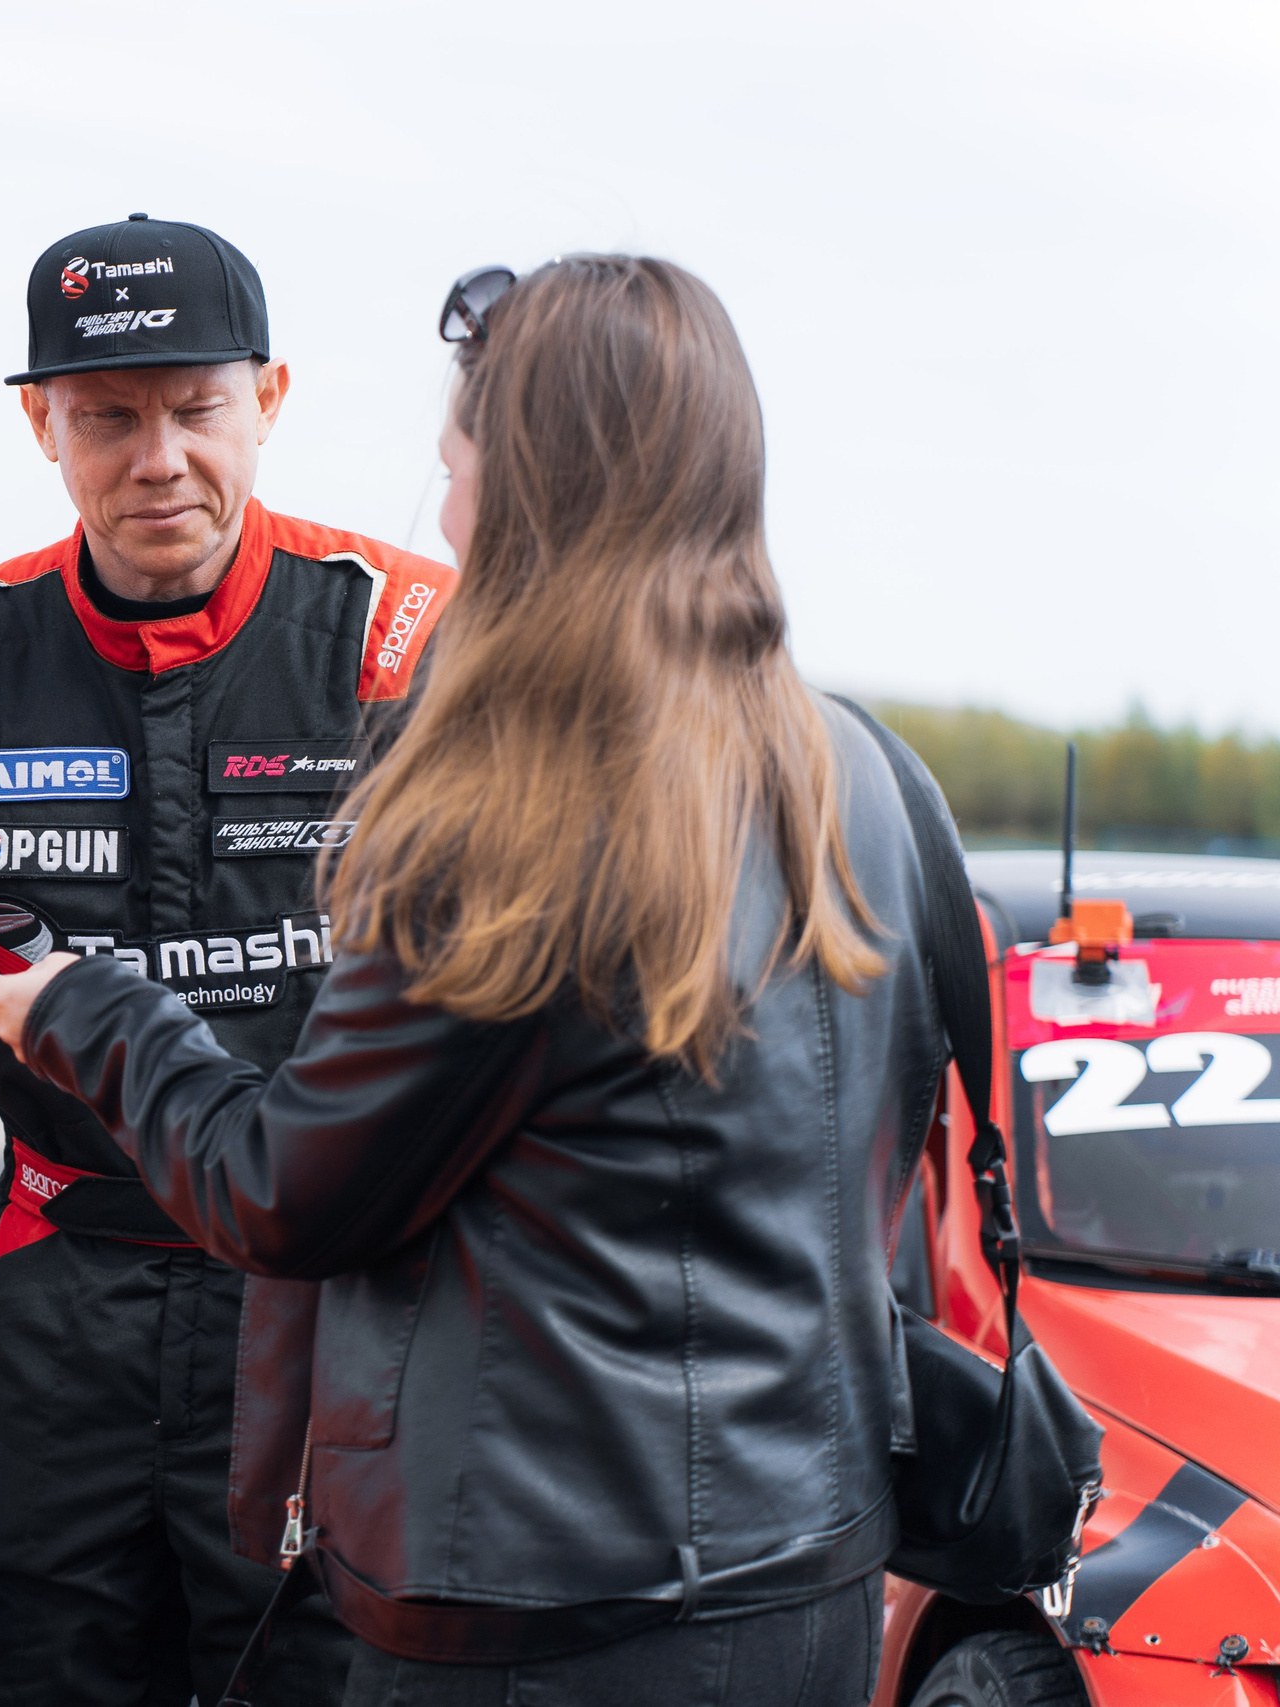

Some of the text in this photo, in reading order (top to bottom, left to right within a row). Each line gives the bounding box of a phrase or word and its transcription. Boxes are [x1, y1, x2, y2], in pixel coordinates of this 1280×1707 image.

[91, 257, 174, 280] Tamashi
[74, 310, 135, 328] КУЛЬТУРА
[82, 321, 130, 337] ЗАНОСА
[377, 583, 433, 671] sparco
[223, 755, 357, 777] RDS OPEN
[217, 821, 304, 837] КУЛЬТУРА
[227, 835, 295, 850] ЗАНОСА
[176, 983, 276, 1005] echnology
[1019, 1031, 1280, 1137] 22
[21, 1164, 69, 1199] sparc
